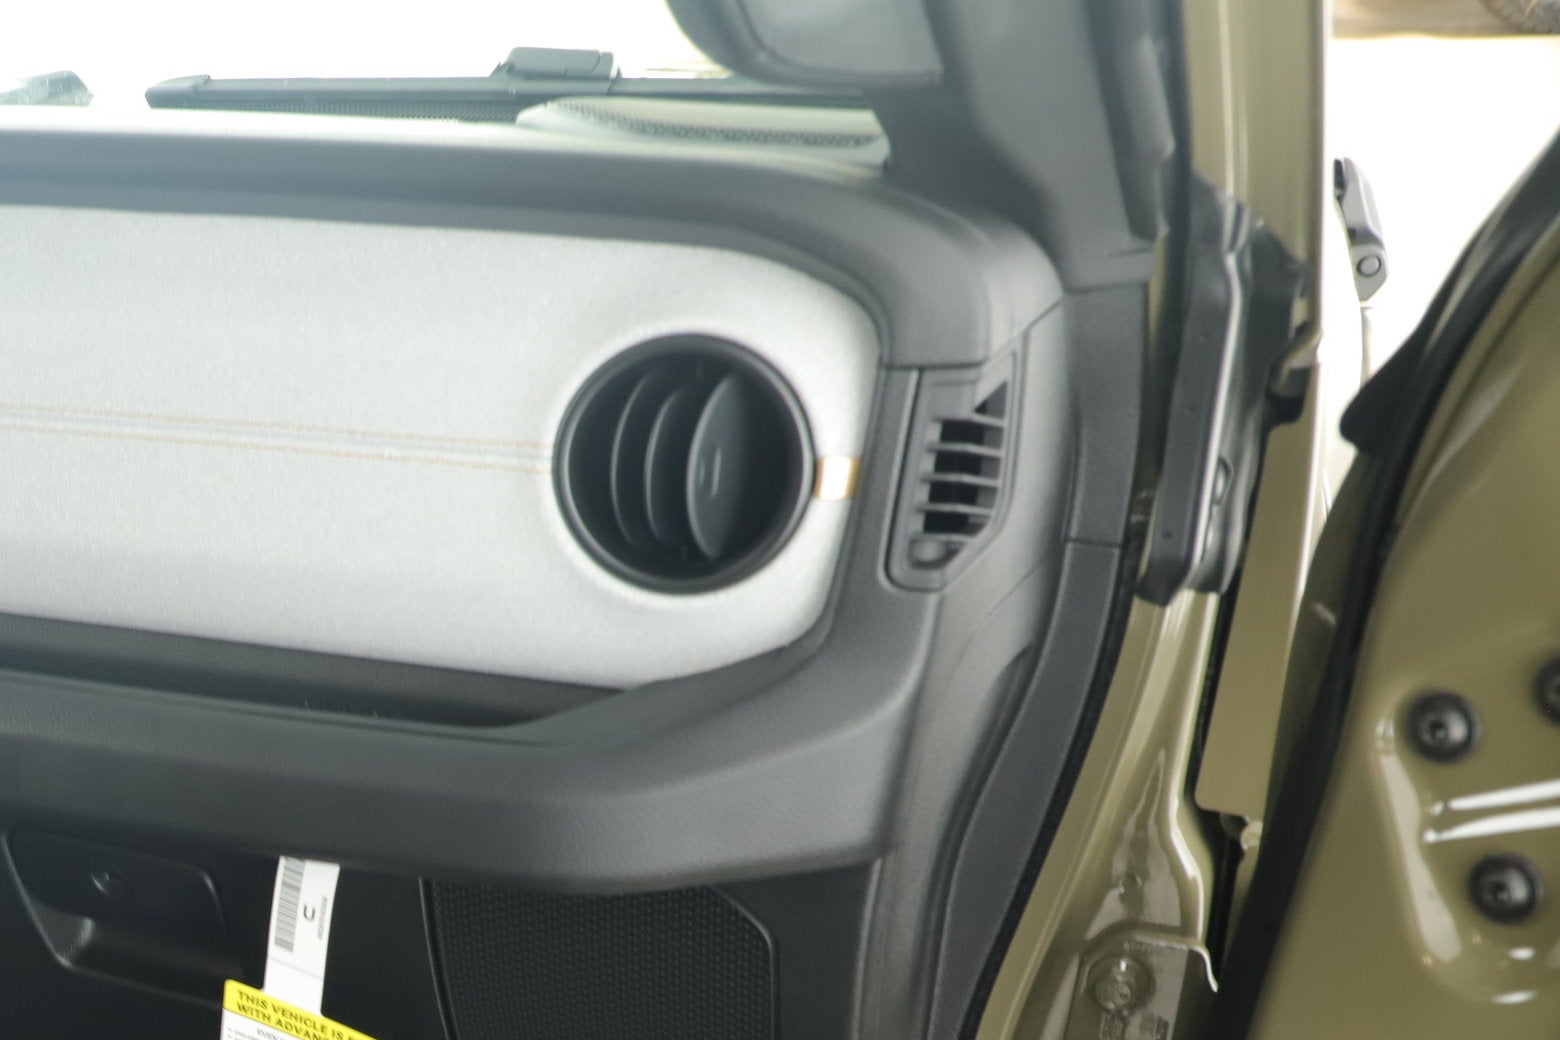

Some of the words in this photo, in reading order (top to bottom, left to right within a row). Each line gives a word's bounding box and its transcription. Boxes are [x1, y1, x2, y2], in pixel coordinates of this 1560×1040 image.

[237, 990, 268, 1009] THIS
[271, 1004, 328, 1034] VEHICLE
[237, 1002, 271, 1022] WITH
